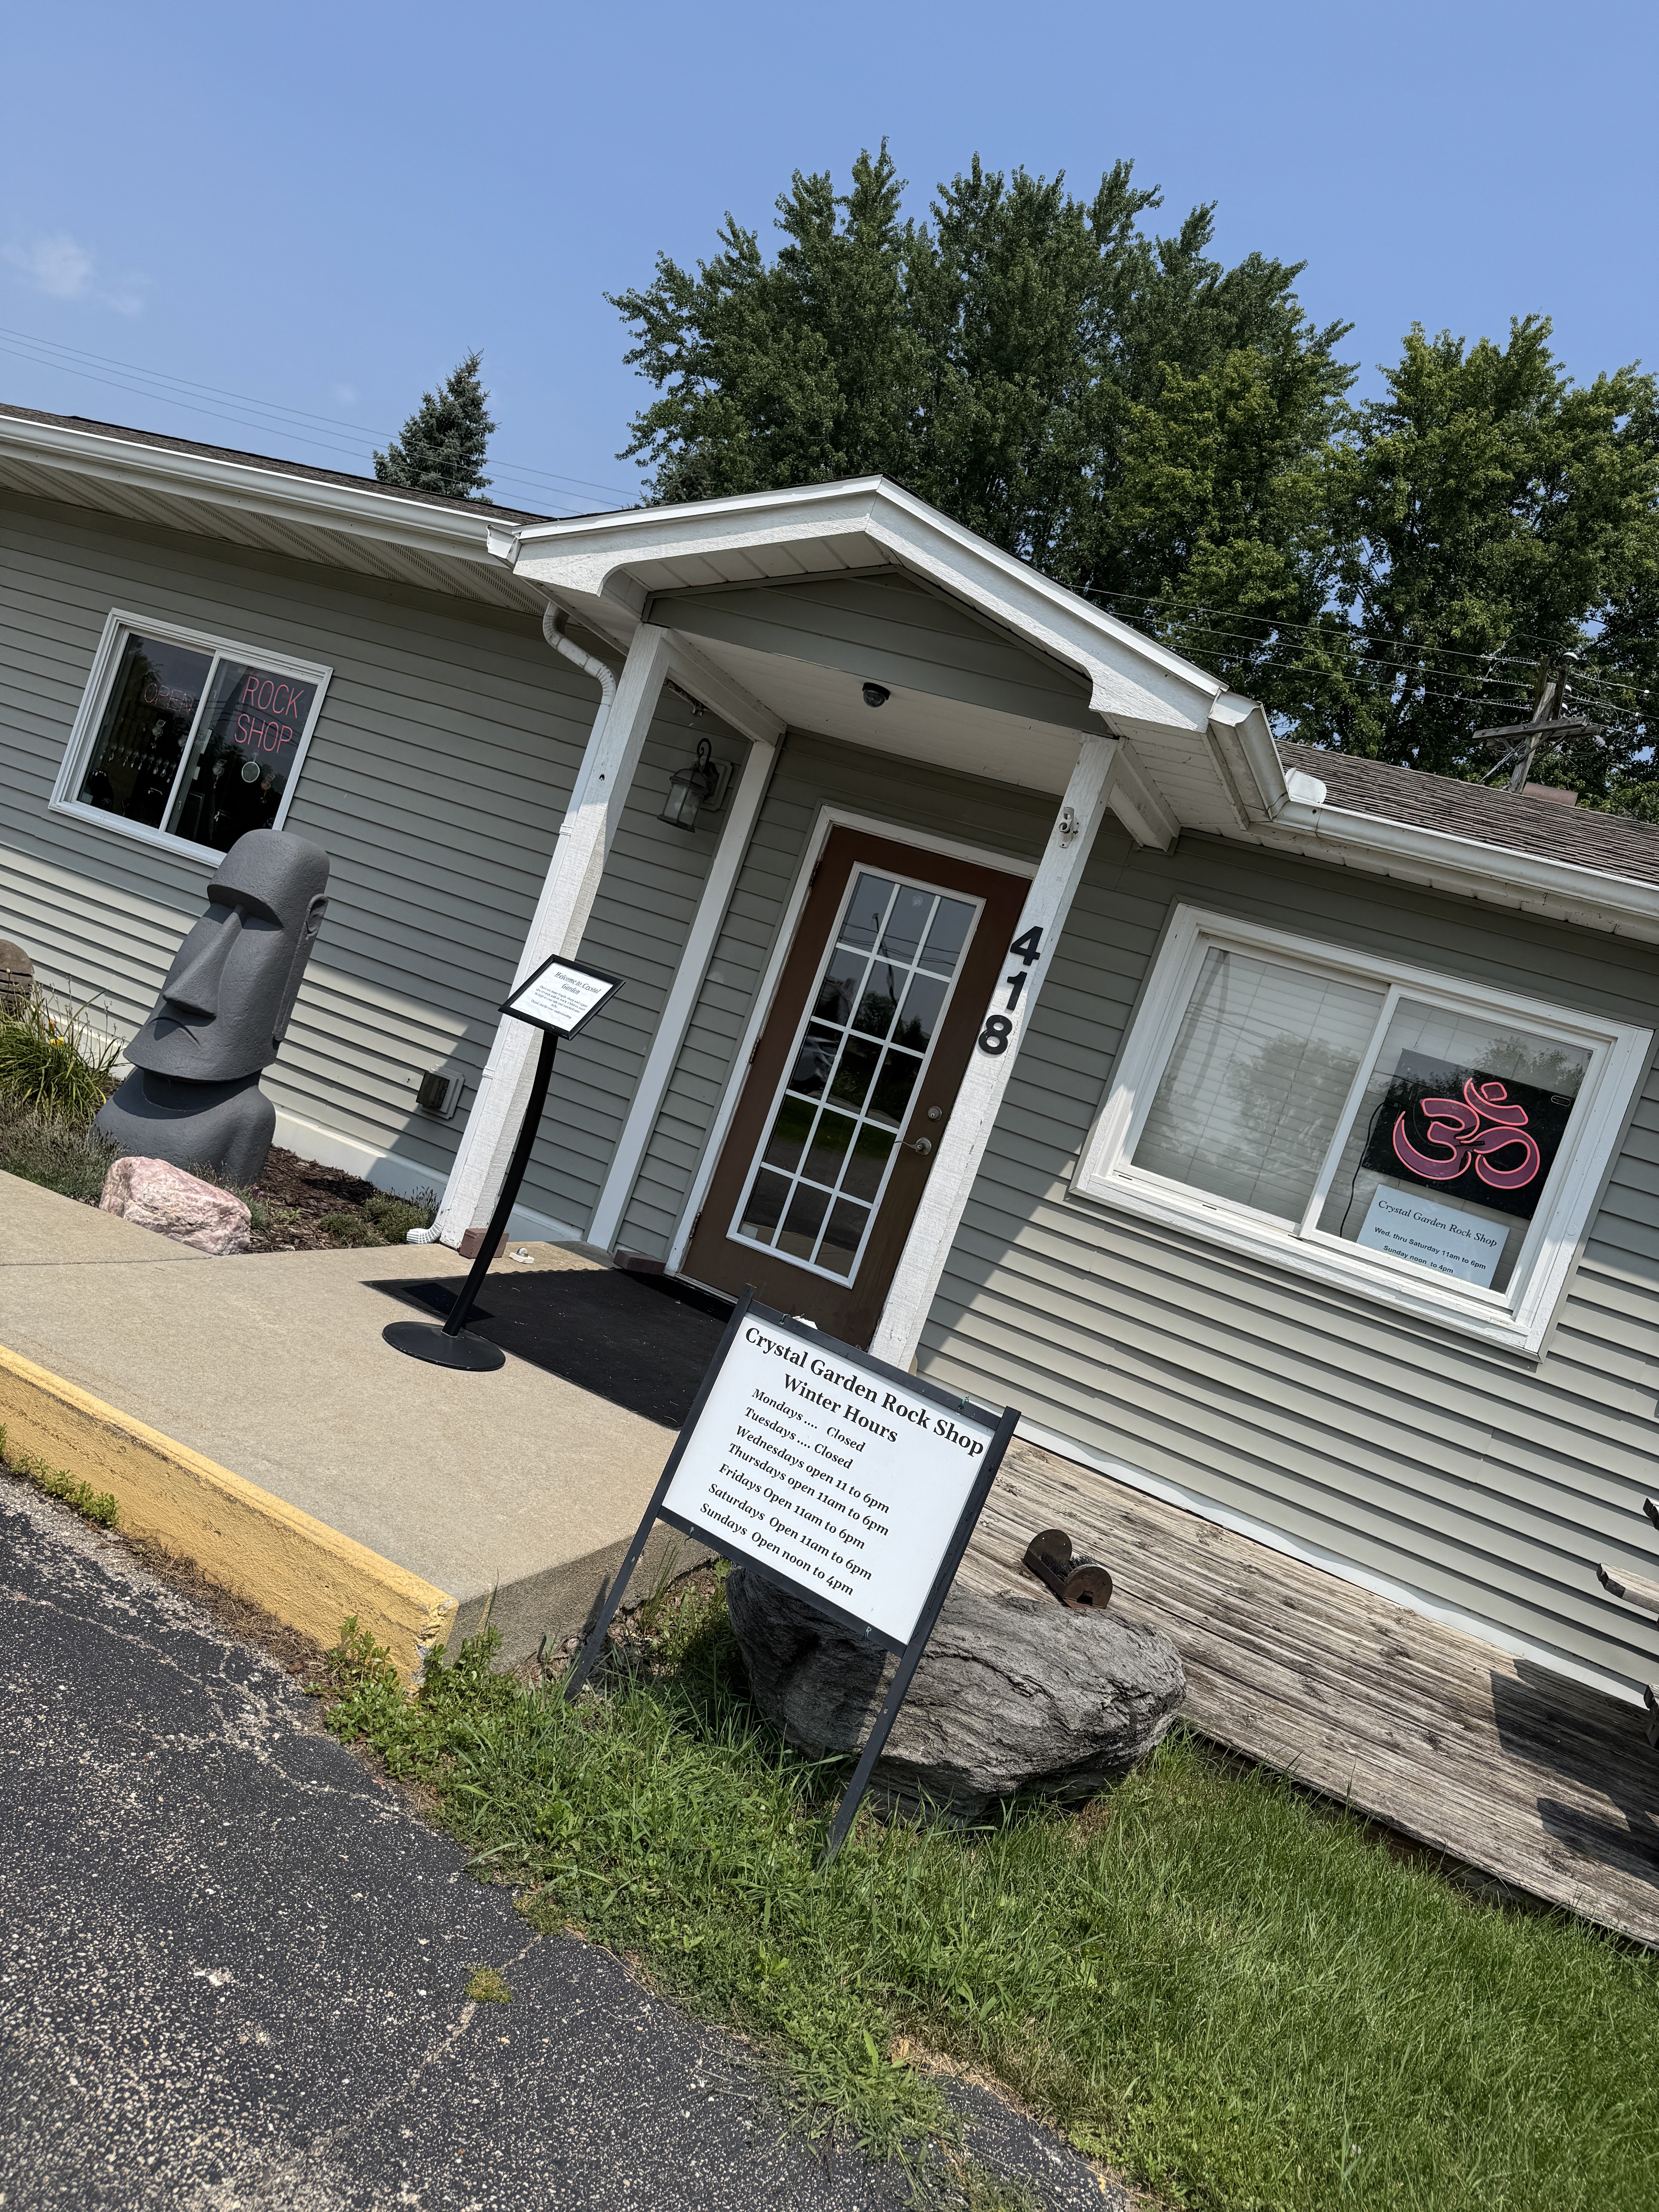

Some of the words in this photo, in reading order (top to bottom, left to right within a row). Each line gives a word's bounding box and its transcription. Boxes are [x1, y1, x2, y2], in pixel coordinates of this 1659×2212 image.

[144, 683, 194, 715] OPEN
[242, 676, 304, 719] ROCK
[234, 714, 293, 753] SHOP
[555, 972, 577, 984] Welcome
[582, 984, 601, 993] Crystal
[561, 984, 580, 994] Garden
[979, 926, 1043, 1055] 418
[1375, 1227, 1390, 1237] Wed.
[1409, 1239, 1440, 1254] Saturday
[1443, 1251, 1460, 1261] 11am
[1471, 1261, 1486, 1269] 6pm
[1379, 1201, 1411, 1217] Crystal
[1414, 1212, 1446, 1229] Garden
[1449, 1224, 1471, 1237] Rock
[1474, 1233, 1496, 1247] Shop
[1384, 1246, 1408, 1258] Sunday
[1410, 1256, 1426, 1264] noon
[746, 1328, 808, 1368] Crystal
[811, 1360, 877, 1403] Garden
[881, 1393, 931, 1429] Rock
[934, 1420, 983, 1457] Shop
[752, 1389, 803, 1420] Mondays
[827, 1427, 866, 1452] Closed
[785, 1374, 841, 1413] Winter
[843, 1405, 897, 1442] Hours
[737, 1425, 804, 1468] Wednesdays
[806, 1466, 833, 1484] open
[835, 1480, 847, 1491] 11
[849, 1486, 860, 1498] to
[864, 1494, 889, 1513] 6pm
[745, 1407, 796, 1439] Tuesdays
[815, 1444, 853, 1469] Closed
[719, 1463, 761, 1492] Fridays
[764, 1488, 792, 1509] Open
[793, 1506, 822, 1526] 11am
[824, 1522, 836, 1533] to
[839, 1529, 864, 1549] 6pm
[729, 1443, 786, 1480] Thursdays
[788, 1478, 815, 1496] open
[817, 1492, 846, 1513] 11am
[848, 1508, 860, 1520] to
[863, 1516, 888, 1535] 6pm
[700, 1504, 747, 1535] Sundays
[752, 1532, 780, 1554] Open
[782, 1551, 811, 1571] noon
[813, 1567, 824, 1578] to
[826, 1576, 853, 1595] 4pm
[709, 1484, 765, 1520] Saturdays
[770, 1517, 798, 1539] Open
[800, 1535, 829, 1556] 11am
[831, 1552, 843, 1563] to
[846, 1560, 871, 1580] 6pm
